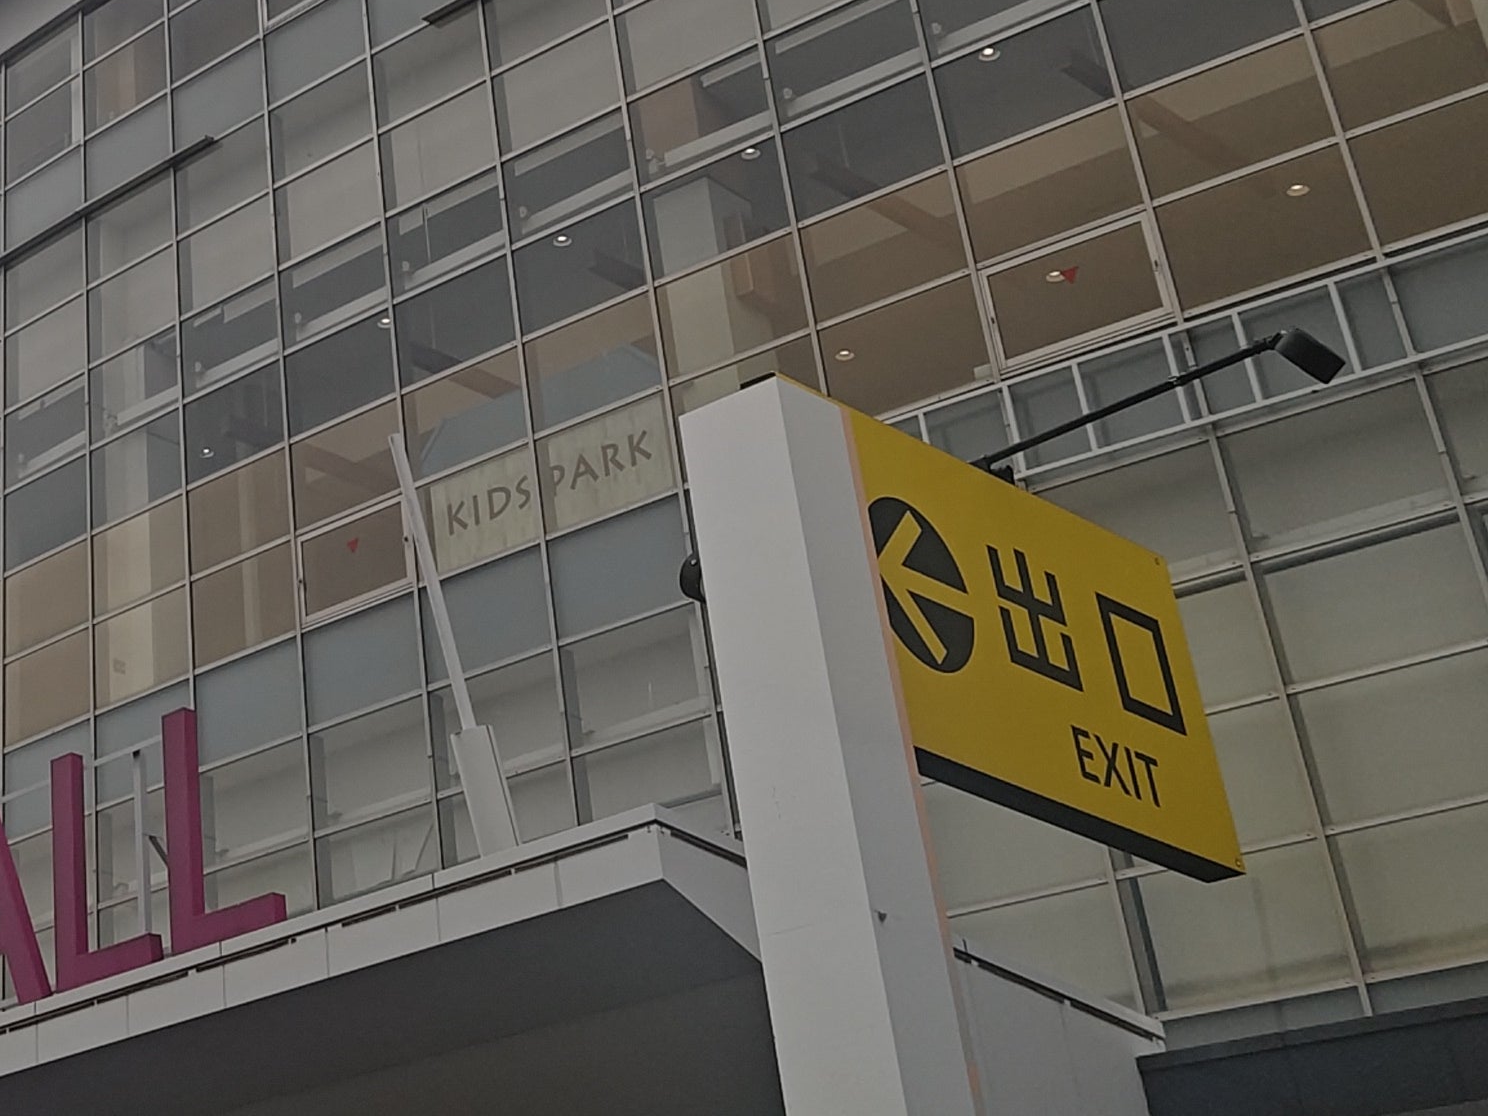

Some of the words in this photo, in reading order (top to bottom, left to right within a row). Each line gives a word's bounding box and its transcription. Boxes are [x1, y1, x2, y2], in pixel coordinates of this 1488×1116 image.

[446, 475, 531, 536] KIDS
[549, 429, 653, 497] PARK
[985, 544, 1187, 736] 出口
[1071, 724, 1161, 808] EXIT
